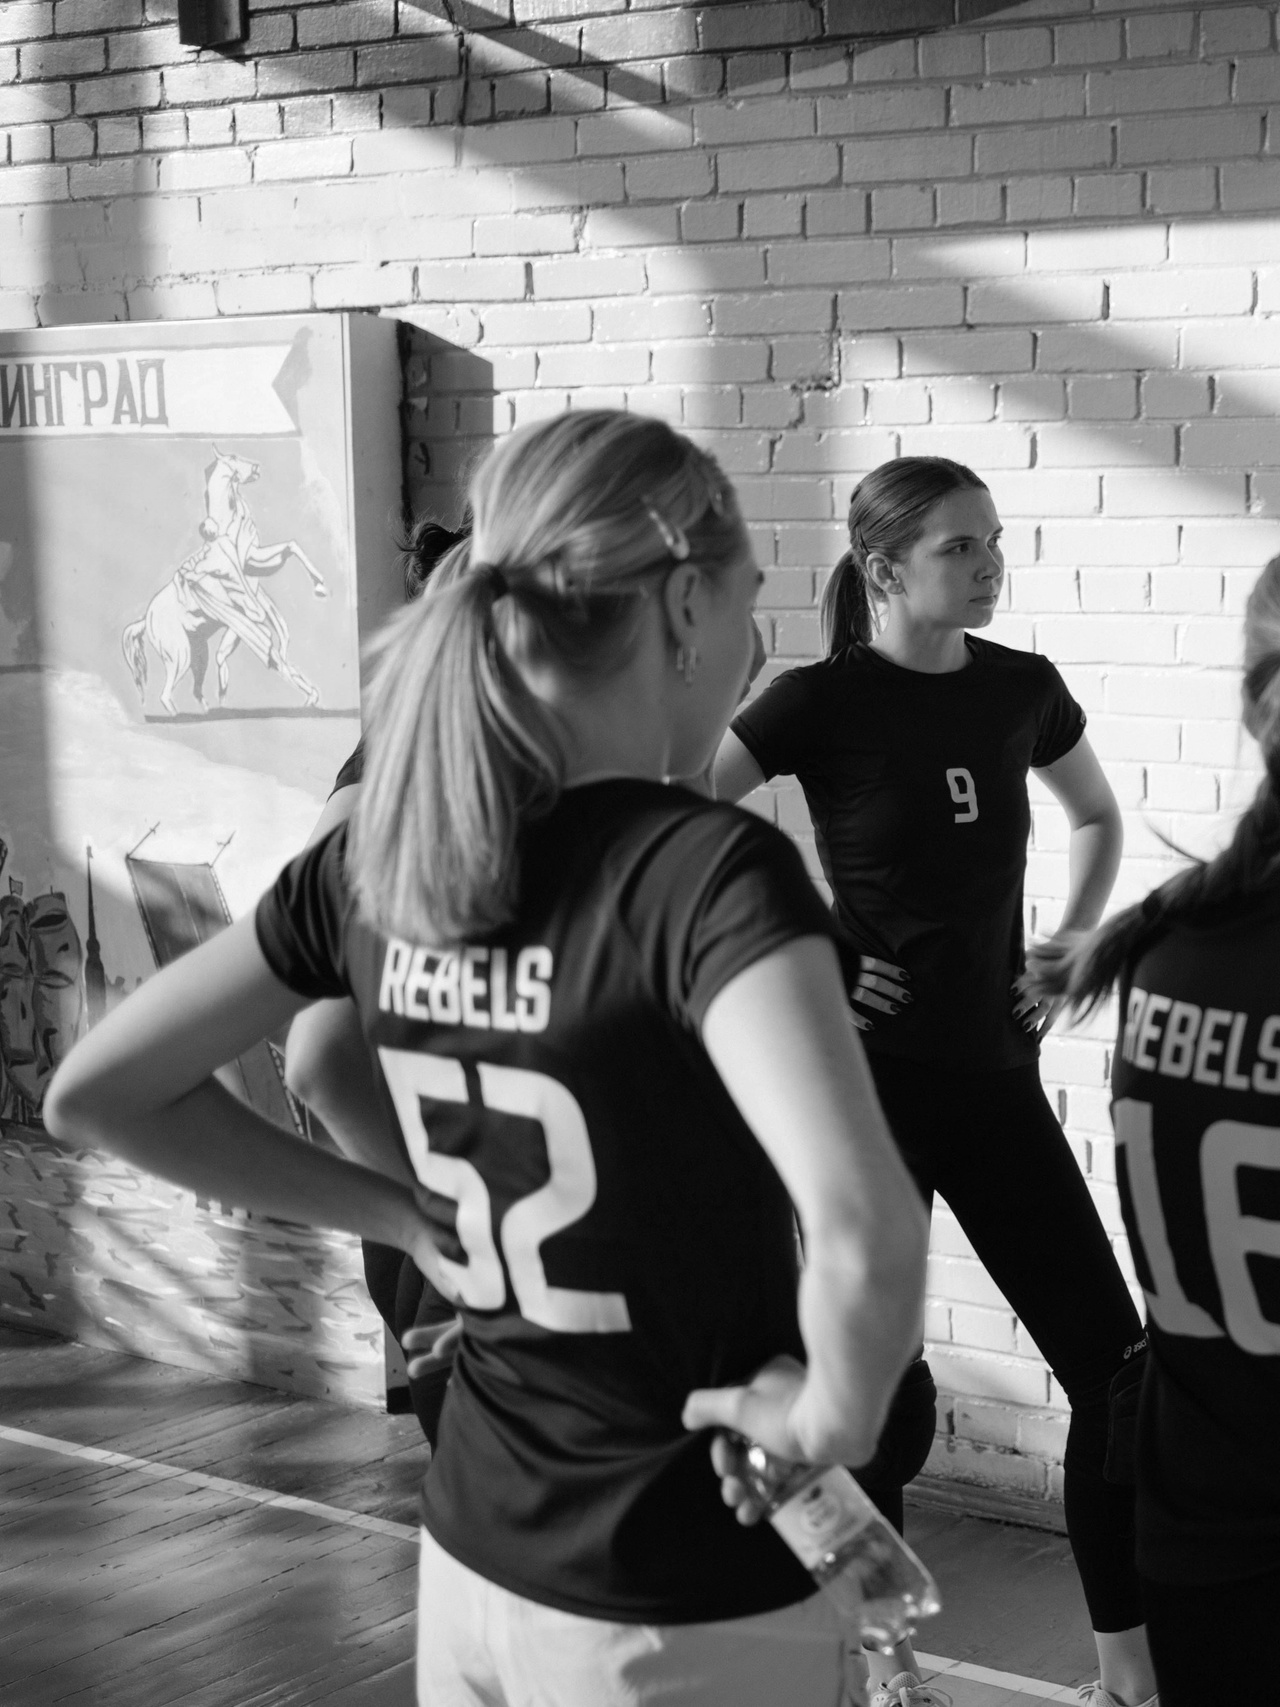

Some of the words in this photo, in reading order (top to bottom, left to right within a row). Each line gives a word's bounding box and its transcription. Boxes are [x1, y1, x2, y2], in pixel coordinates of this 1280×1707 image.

[946, 767, 979, 823] 9
[379, 938, 553, 1033] REBELS
[378, 1045, 632, 1333] 52
